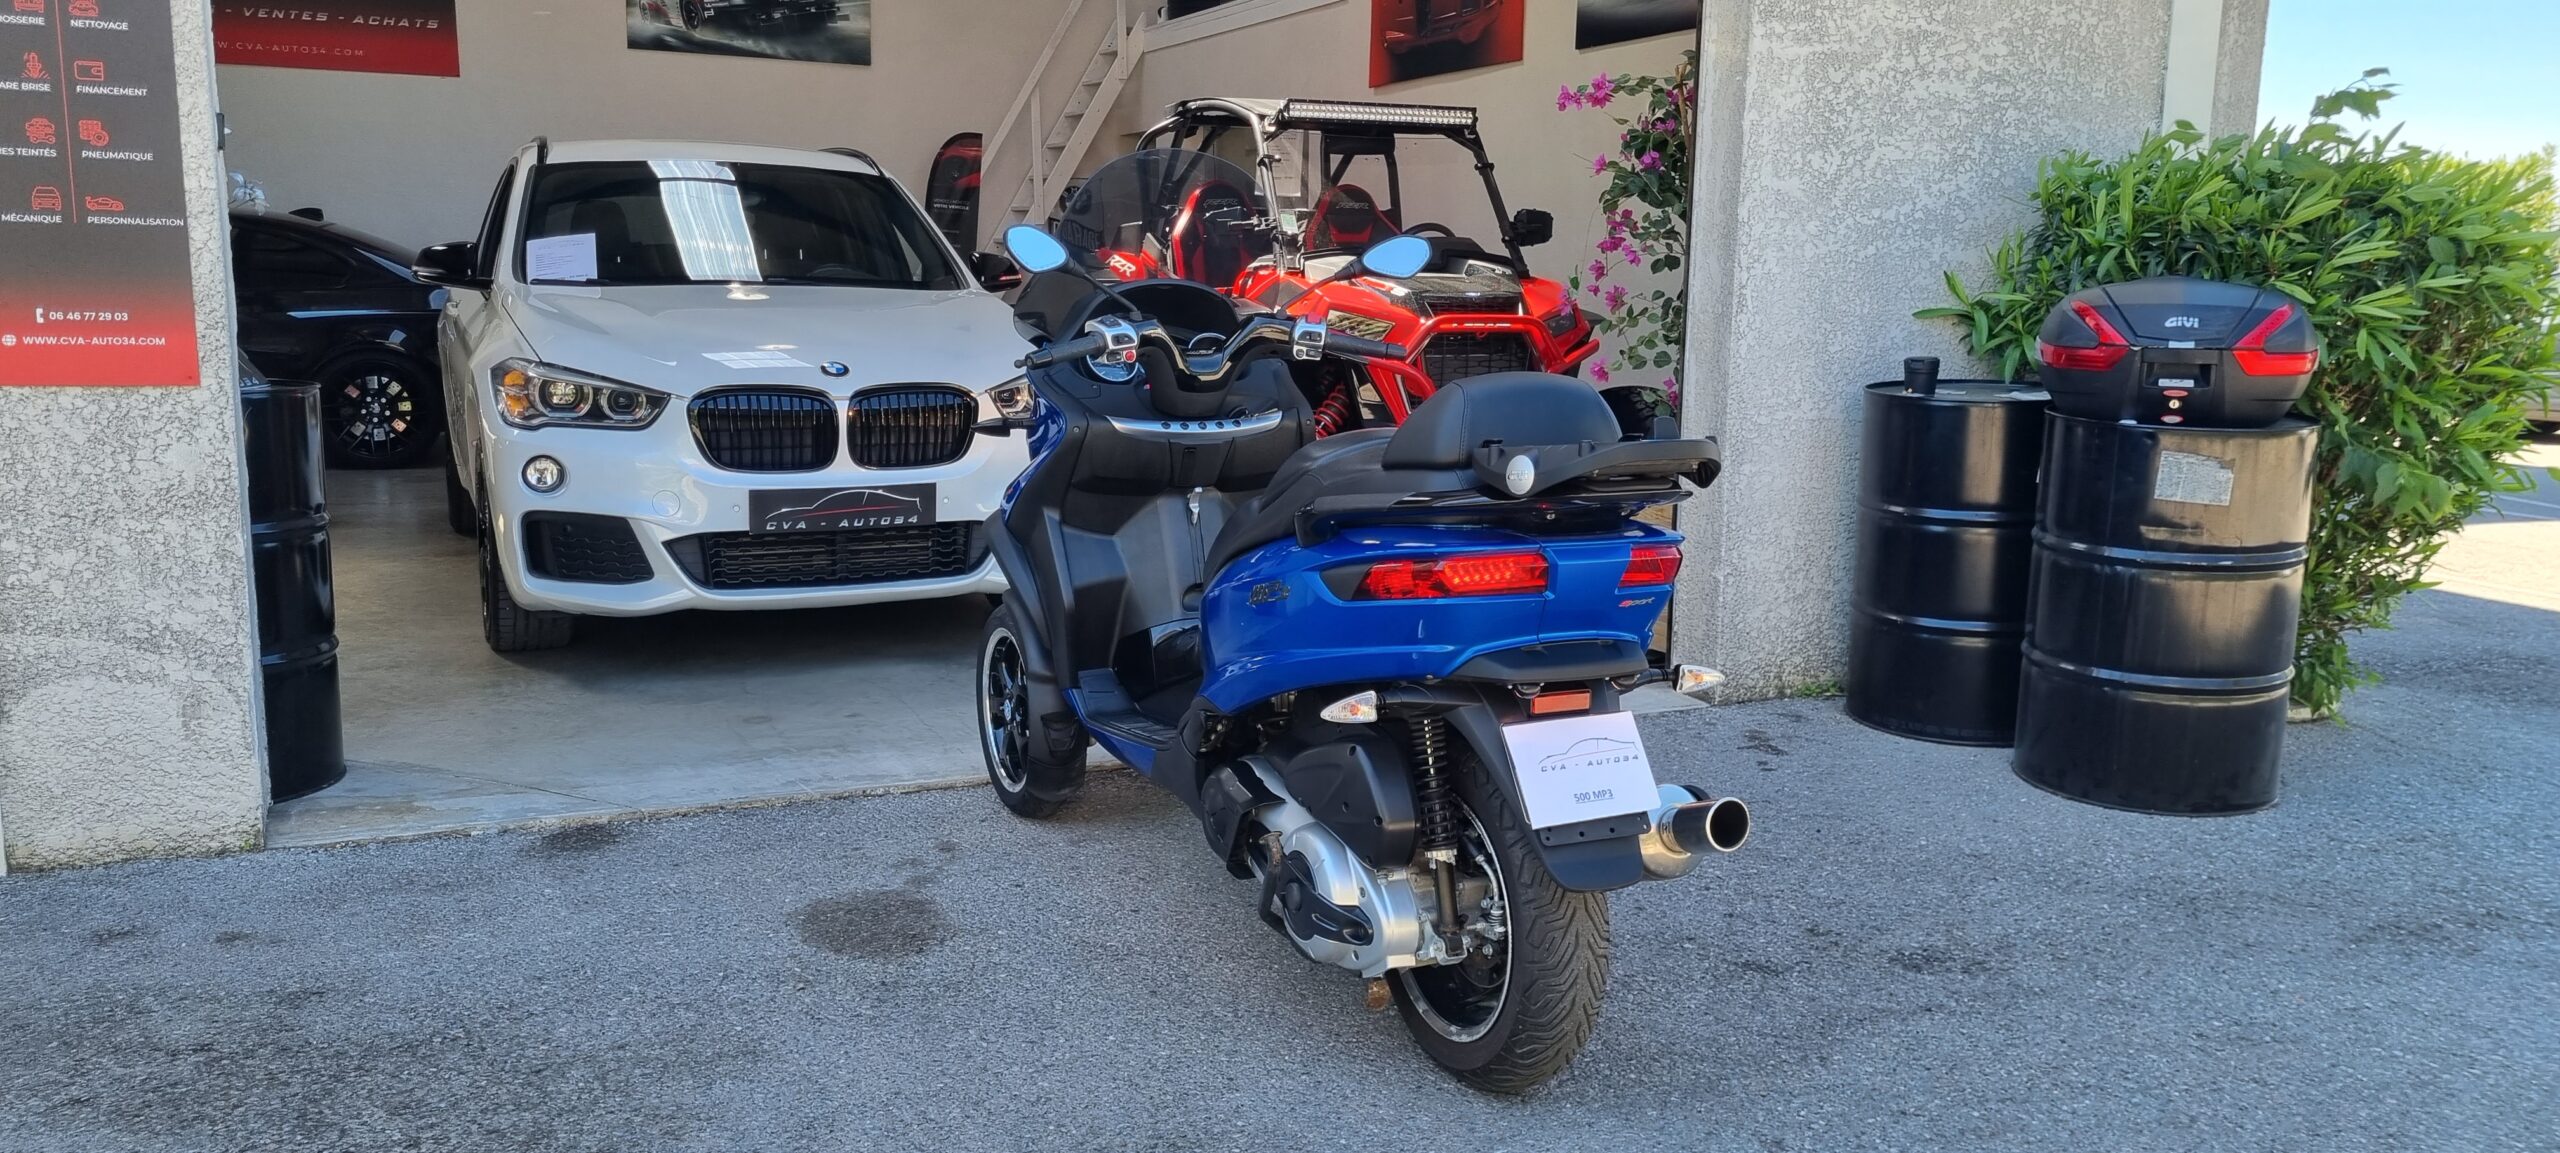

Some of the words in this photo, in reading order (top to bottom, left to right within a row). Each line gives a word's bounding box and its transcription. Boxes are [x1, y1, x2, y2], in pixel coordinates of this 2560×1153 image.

[243, 7, 329, 21] VENTES
[352, 15, 440, 29] ACHATS
[69, 19, 129, 31] NETTOYAGE
[21, 82, 51, 92] BRISE
[76, 85, 148, 96] FINANCEMENT
[0, 147, 14, 156] ES
[82, 150, 154, 161] PNEUMATIQUE
[1, 213, 62, 224] MÉCANIQUE
[87, 215, 184, 226] PERSONNALISATION
[1105, 254, 1137, 277] RZR
[49, 311, 63, 320] 06
[66, 311, 81, 321] 46
[83, 311, 96, 321] 77
[98, 311, 112, 321] 29
[114, 312, 128, 321] 03
[22, 335, 166, 346] WWW.CVA-AUTO34.COM
[765, 520, 807, 530] CVA
[838, 514, 918, 528] AUTO34
[1541, 764, 1566, 772] CVA
[1587, 754, 1639, 767] AUTO34
[1573, 791, 1591, 803] 500
[1593, 788, 1614, 801] MP3
